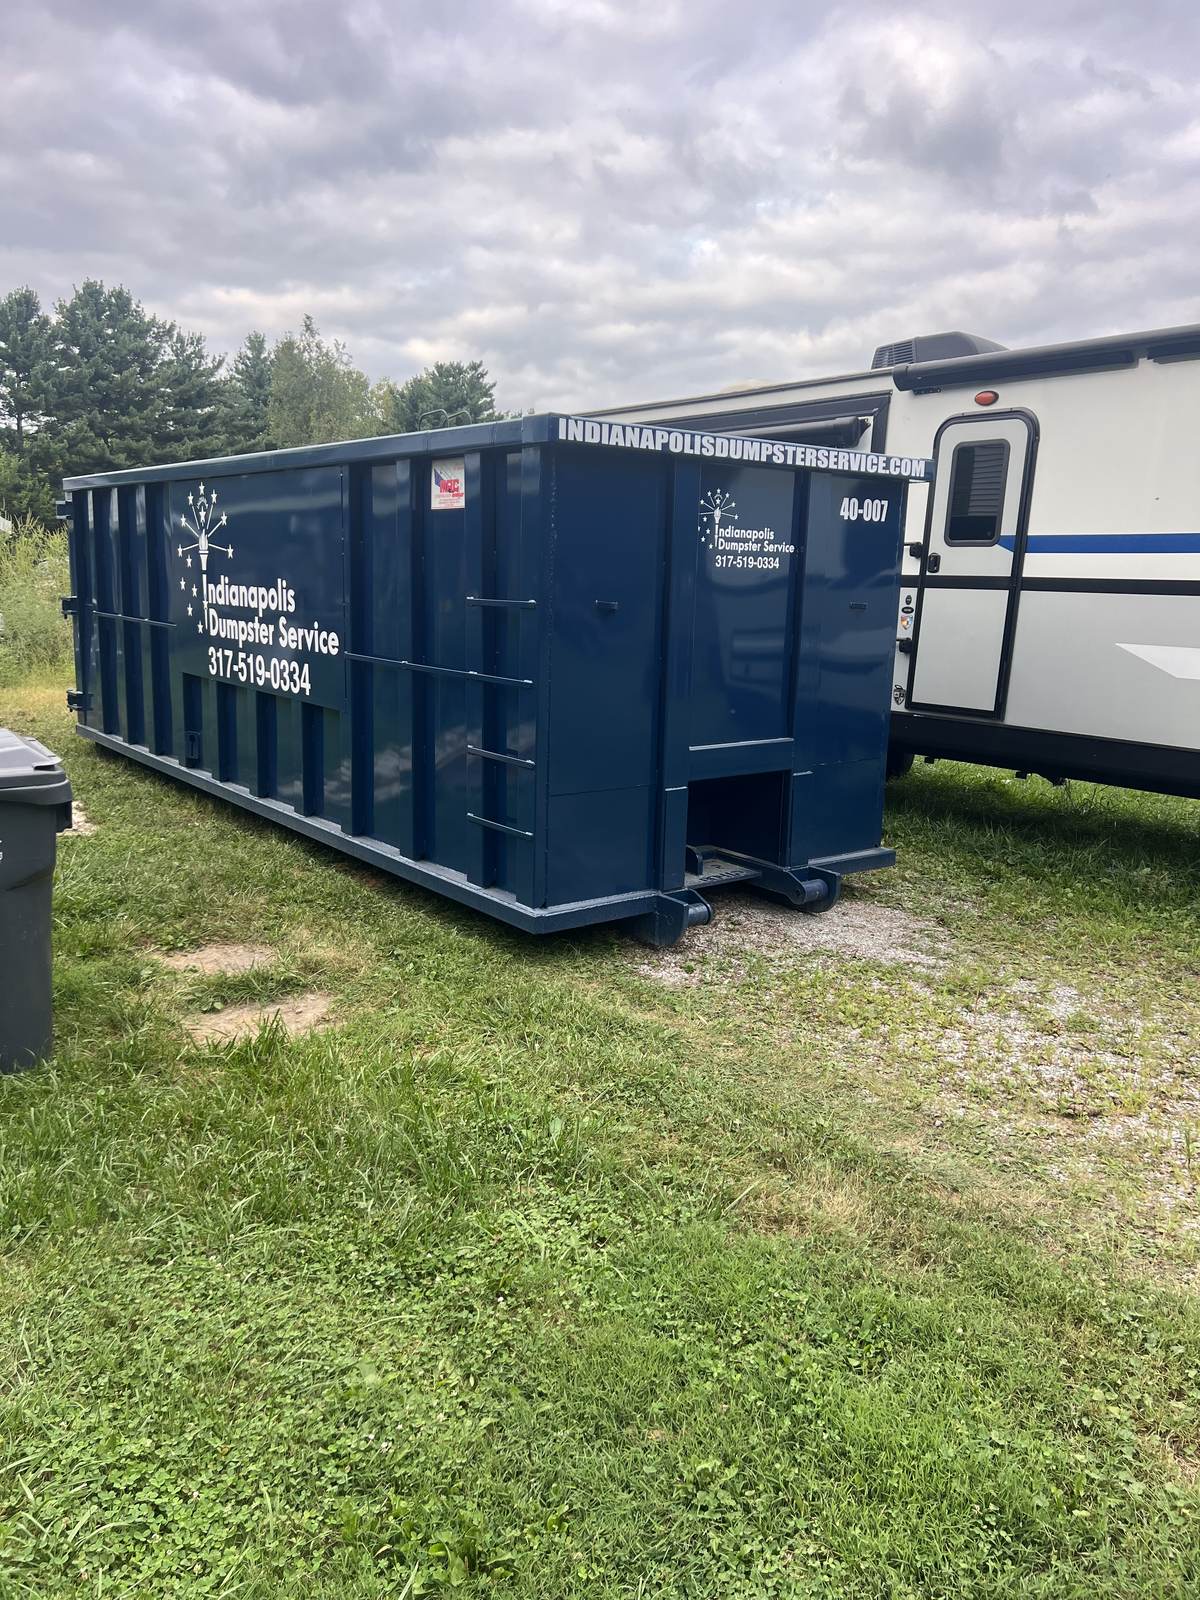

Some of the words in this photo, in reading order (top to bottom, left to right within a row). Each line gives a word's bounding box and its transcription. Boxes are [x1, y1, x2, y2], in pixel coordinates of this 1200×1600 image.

[558, 417, 926, 477] INDIANAPOLISDUMPSTERSERVICE.COM
[840, 497, 888, 522] 40-007
[715, 524, 775, 542] Indianapolis
[718, 538, 761, 553] Dumpster
[763, 541, 795, 553] Service
[715, 555, 780, 569] 317-519-0334
[202, 574, 296, 617] Indianapolis
[208, 608, 275, 648] Dumpster
[278, 616, 339, 655] Service
[208, 646, 311, 695] 317-519-0334
